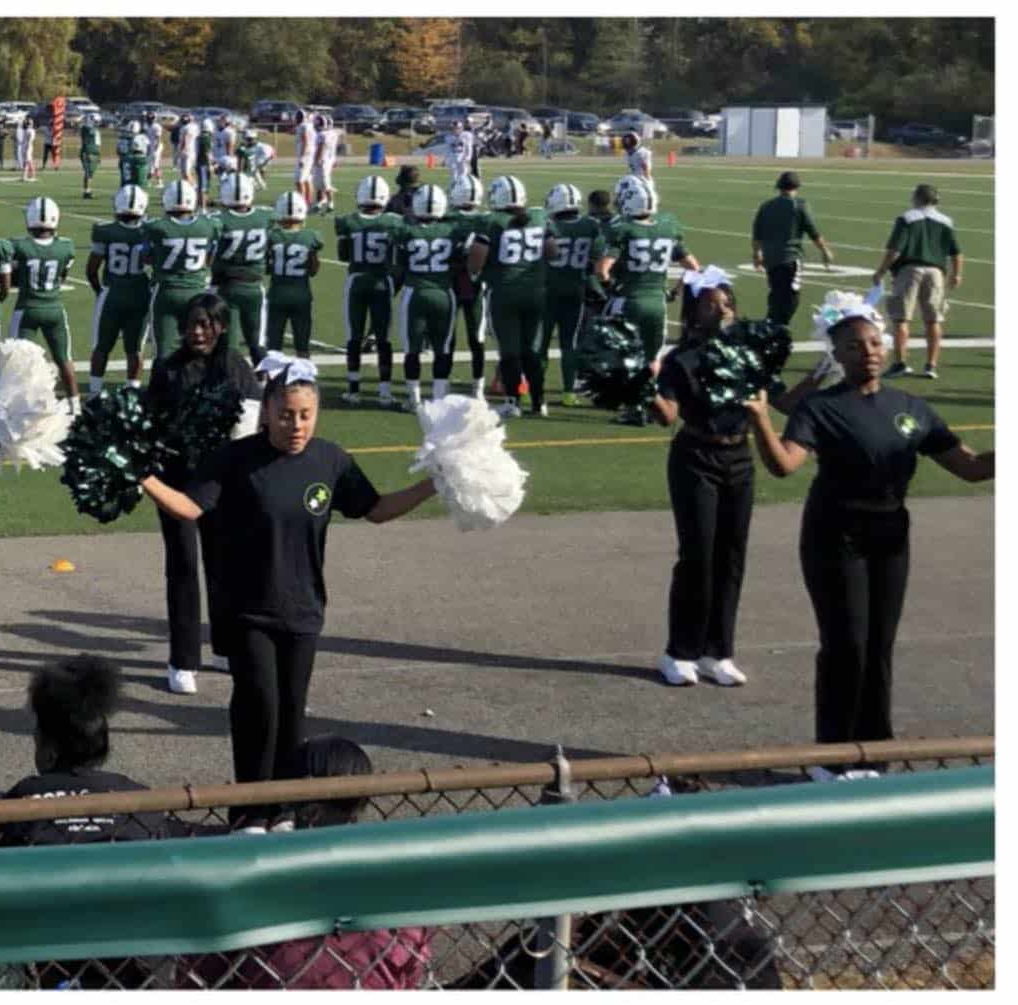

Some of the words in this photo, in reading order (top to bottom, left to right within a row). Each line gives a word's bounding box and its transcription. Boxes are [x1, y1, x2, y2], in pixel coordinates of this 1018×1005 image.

[163, 238, 207, 271] 75
[222, 229, 267, 260] 72
[272, 243, 308, 276] 12
[351, 232, 388, 264] 15
[408, 238, 452, 273] 22
[499, 227, 543, 264] 65
[626, 238, 676, 273] 53
[27, 258, 58, 290] 11
